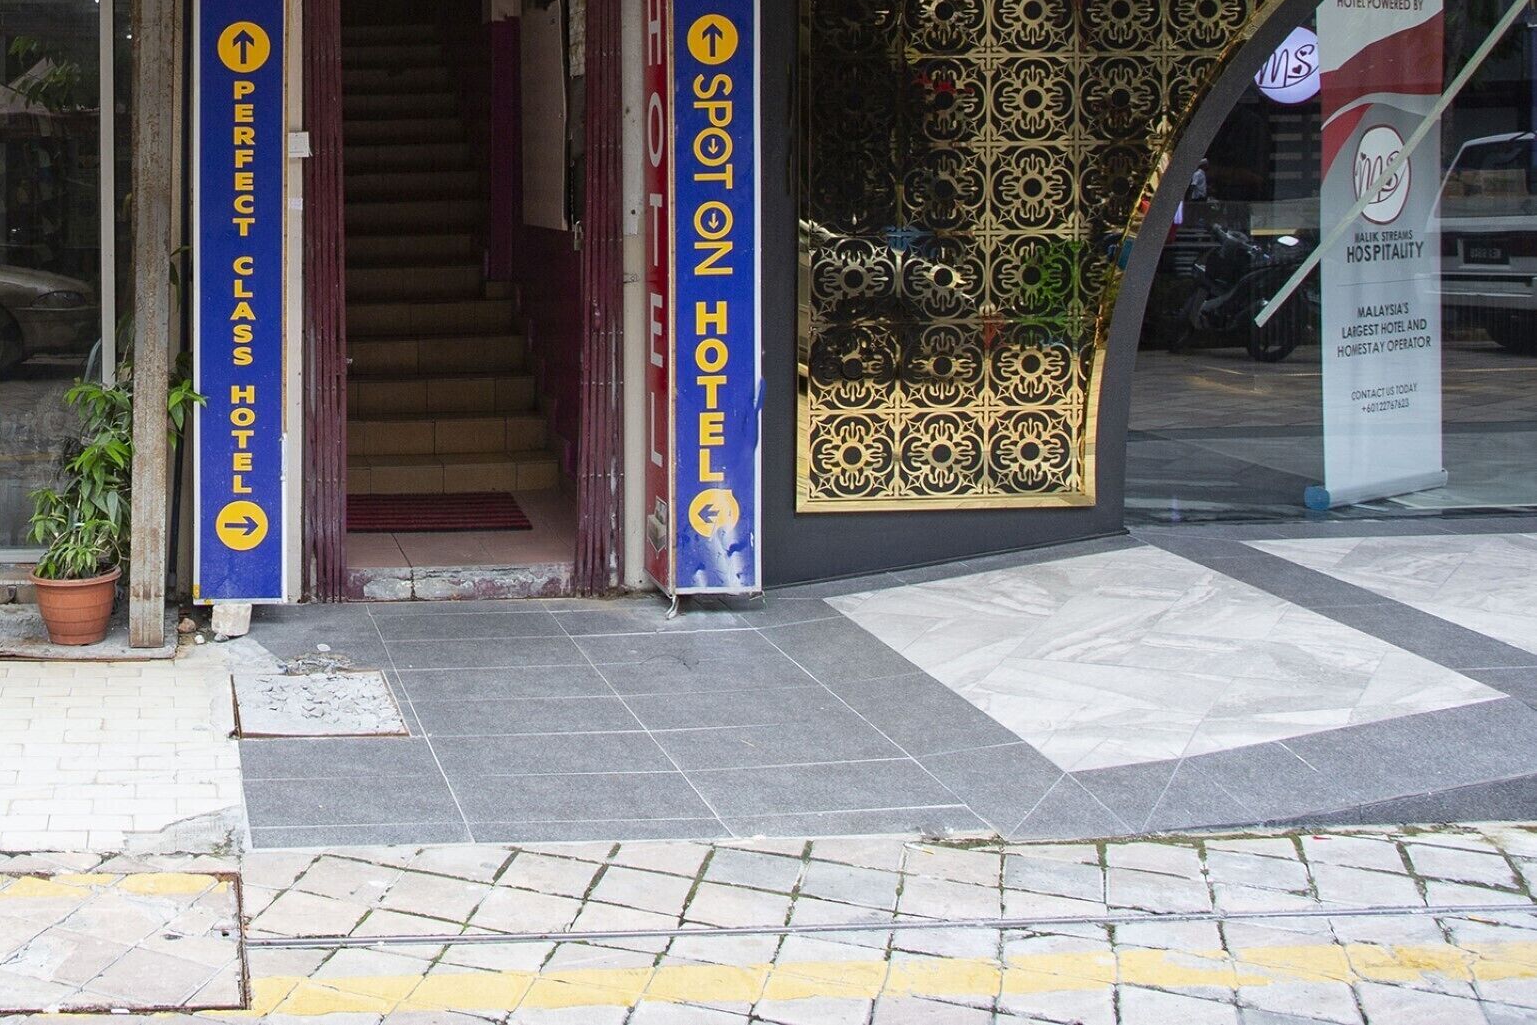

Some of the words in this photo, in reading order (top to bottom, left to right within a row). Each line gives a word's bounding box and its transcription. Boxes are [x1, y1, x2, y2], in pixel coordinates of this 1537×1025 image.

[1411, 0, 1424, 11] BY
[693, 74, 734, 190] SPOT
[231, 80, 257, 237] PERFECT
[693, 201, 734, 276] ON
[1381, 230, 1414, 242] STREAMS
[1347, 241, 1424, 263] HOSPITALITY
[230, 255, 257, 367] CLASS
[1357, 302, 1409, 318] MALAYSIA'S
[1342, 322, 1378, 339] LARGEST
[1380, 321, 1406, 334] HOTEL
[1407, 318, 1427, 331] AND
[1337, 343, 1385, 358] HOMESTAY
[1387, 336, 1431, 351] OPERATOR
[695, 301, 728, 482] HOTEL
[1351, 387, 1385, 400] CONTACT
[1385, 386, 1395, 396] US
[1395, 382, 1418, 394] TODAY
[229, 384, 257, 493] HOTEL
